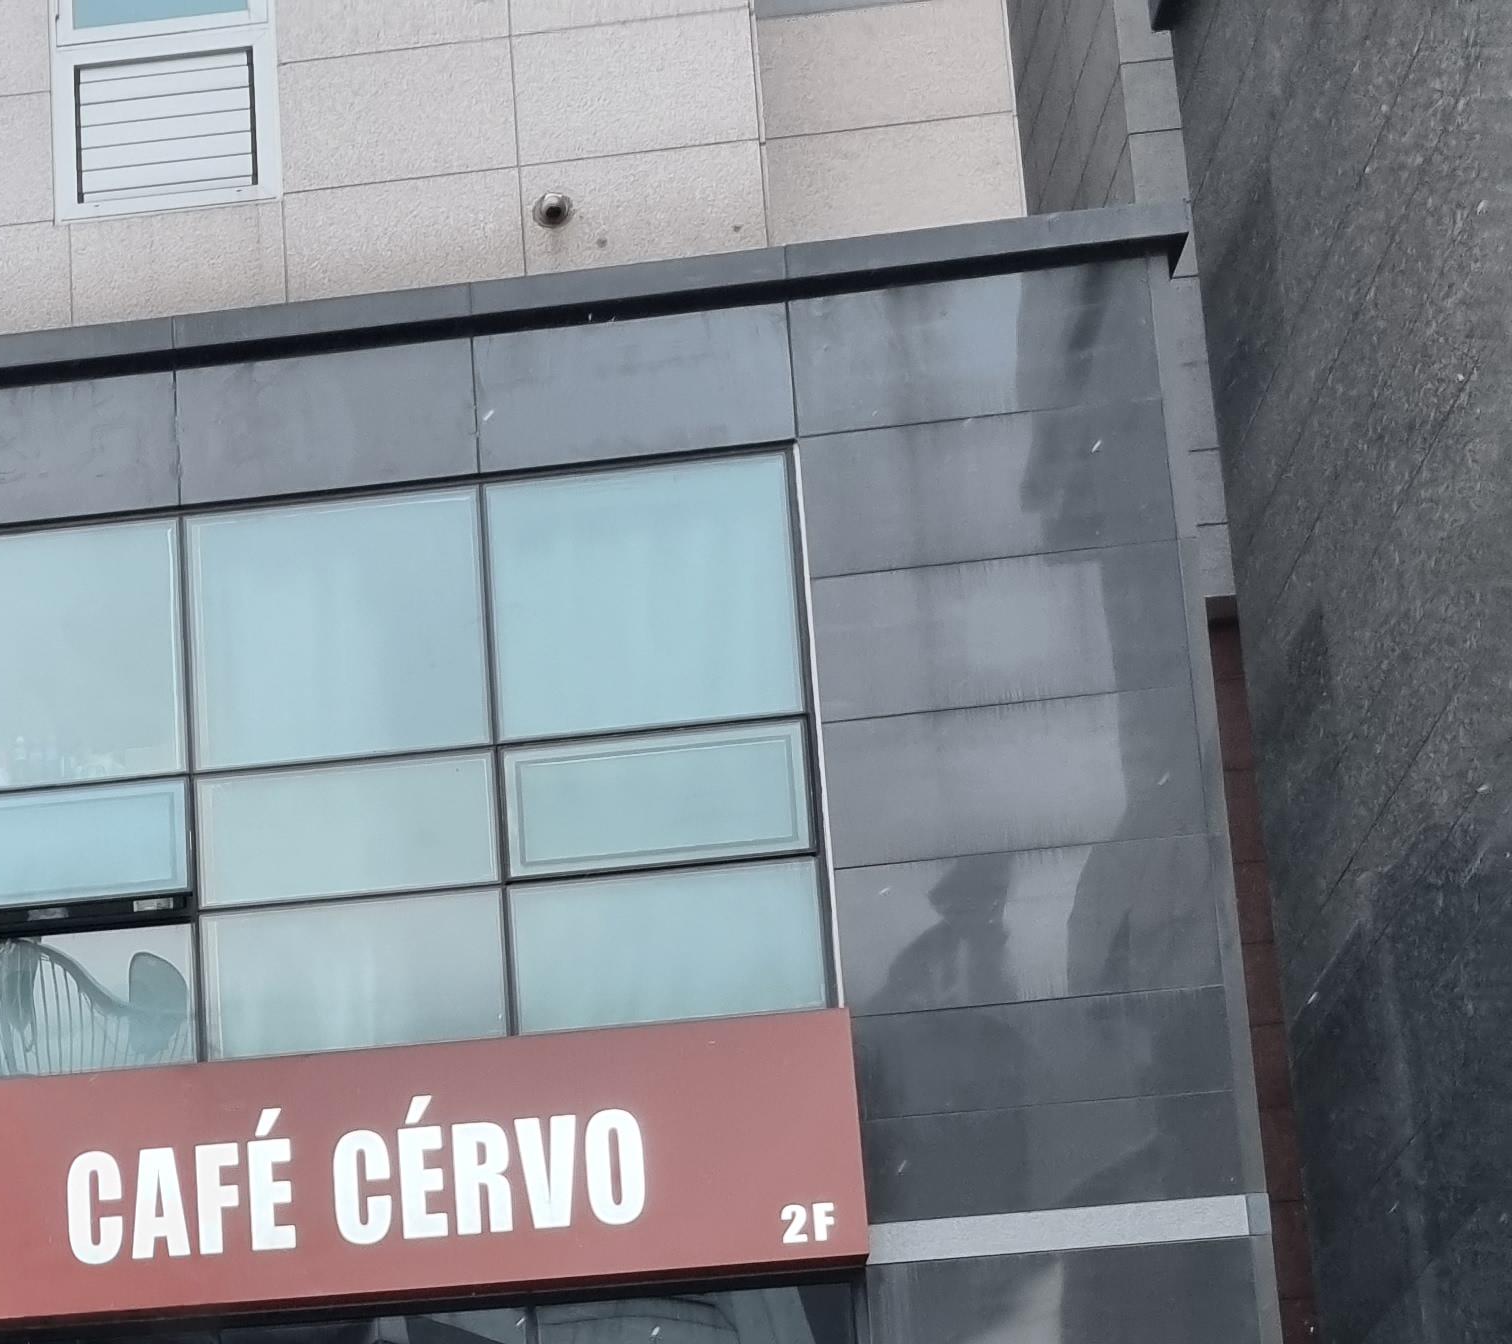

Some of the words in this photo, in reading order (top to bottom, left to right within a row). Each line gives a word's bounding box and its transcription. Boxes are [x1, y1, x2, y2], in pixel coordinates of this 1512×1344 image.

[66, 1108, 296, 1264] CAFÉ
[333, 1095, 646, 1245] CÉRVO
[780, 1202, 835, 1245] 2F
